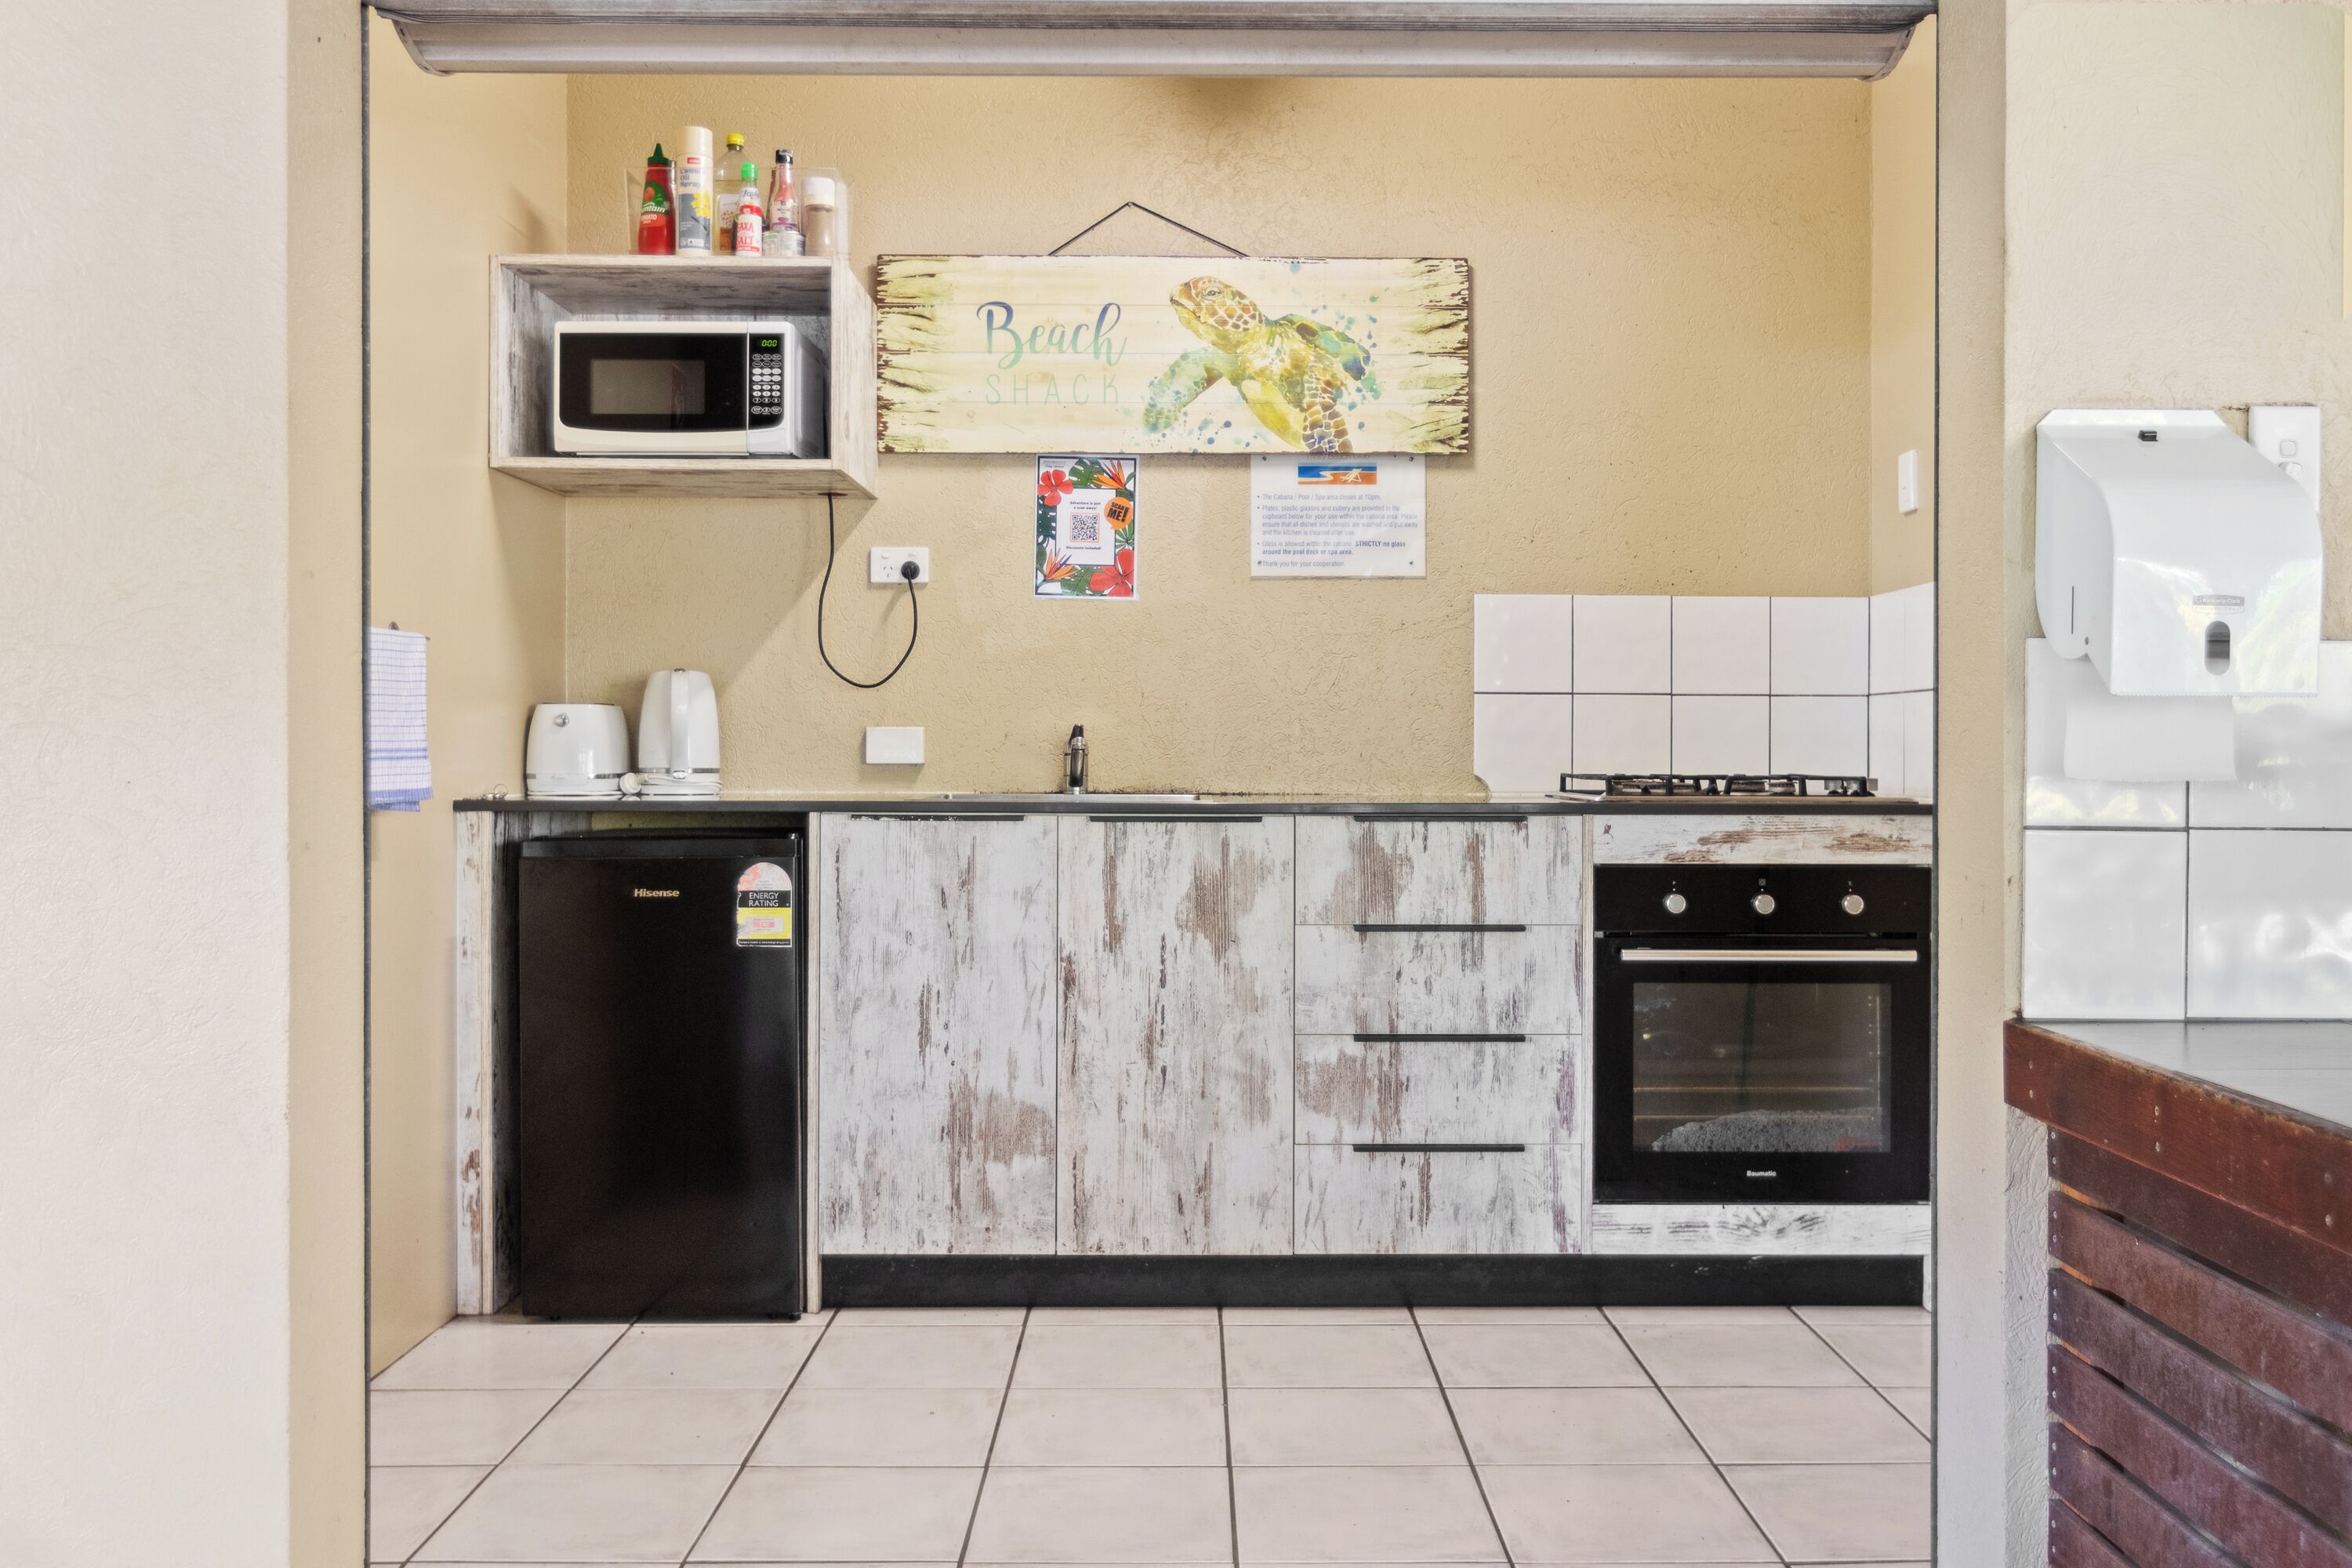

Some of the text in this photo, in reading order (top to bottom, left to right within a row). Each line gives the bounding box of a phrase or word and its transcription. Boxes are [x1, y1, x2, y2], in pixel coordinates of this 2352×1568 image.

[976, 301, 1127, 370] Beach
[985, 373, 1119, 405] SHACK
[1110, 502, 1125, 510] SCAN
[1107, 507, 1129, 522] ME!
[633, 888, 680, 898] Hisense
